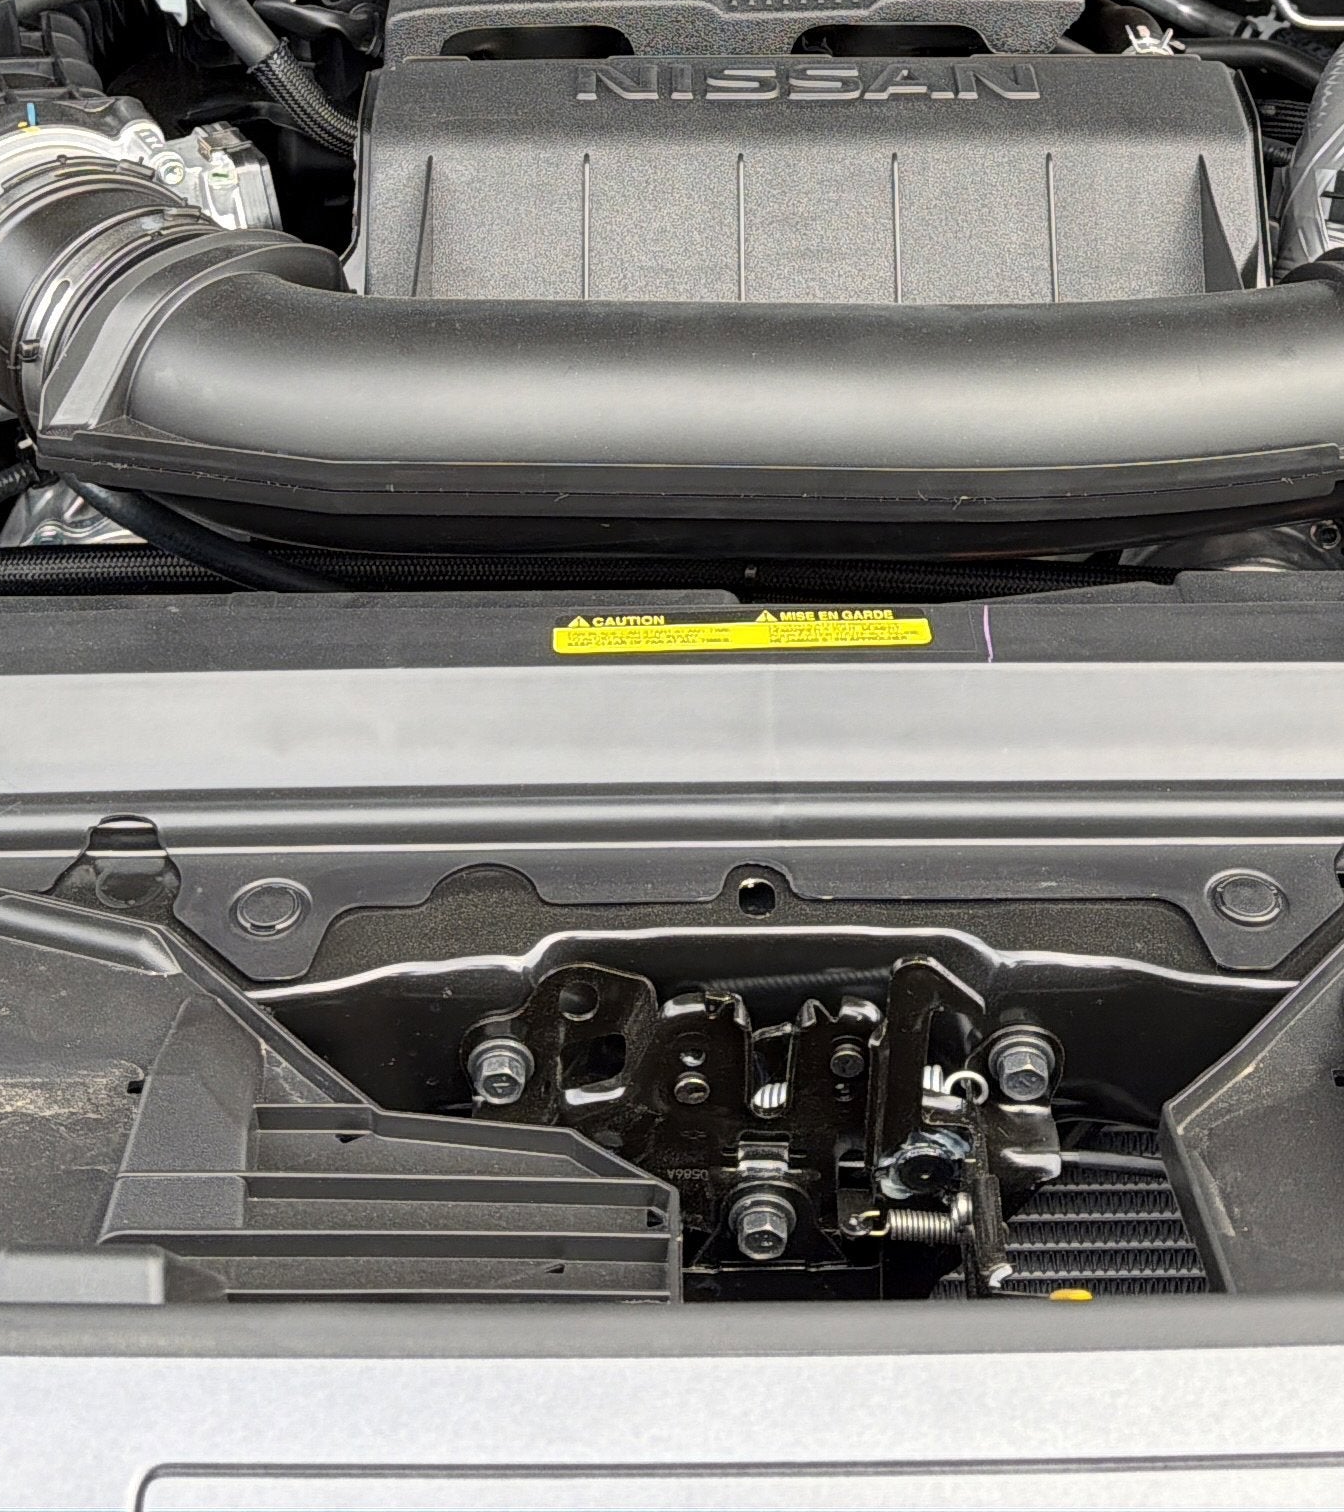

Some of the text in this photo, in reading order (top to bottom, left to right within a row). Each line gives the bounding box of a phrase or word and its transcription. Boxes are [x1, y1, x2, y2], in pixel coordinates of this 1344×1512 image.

[575, 63, 1041, 100] NISSAN
[591, 615, 665, 627] CAUTION
[779, 609, 895, 622] MISE EN GARDE
